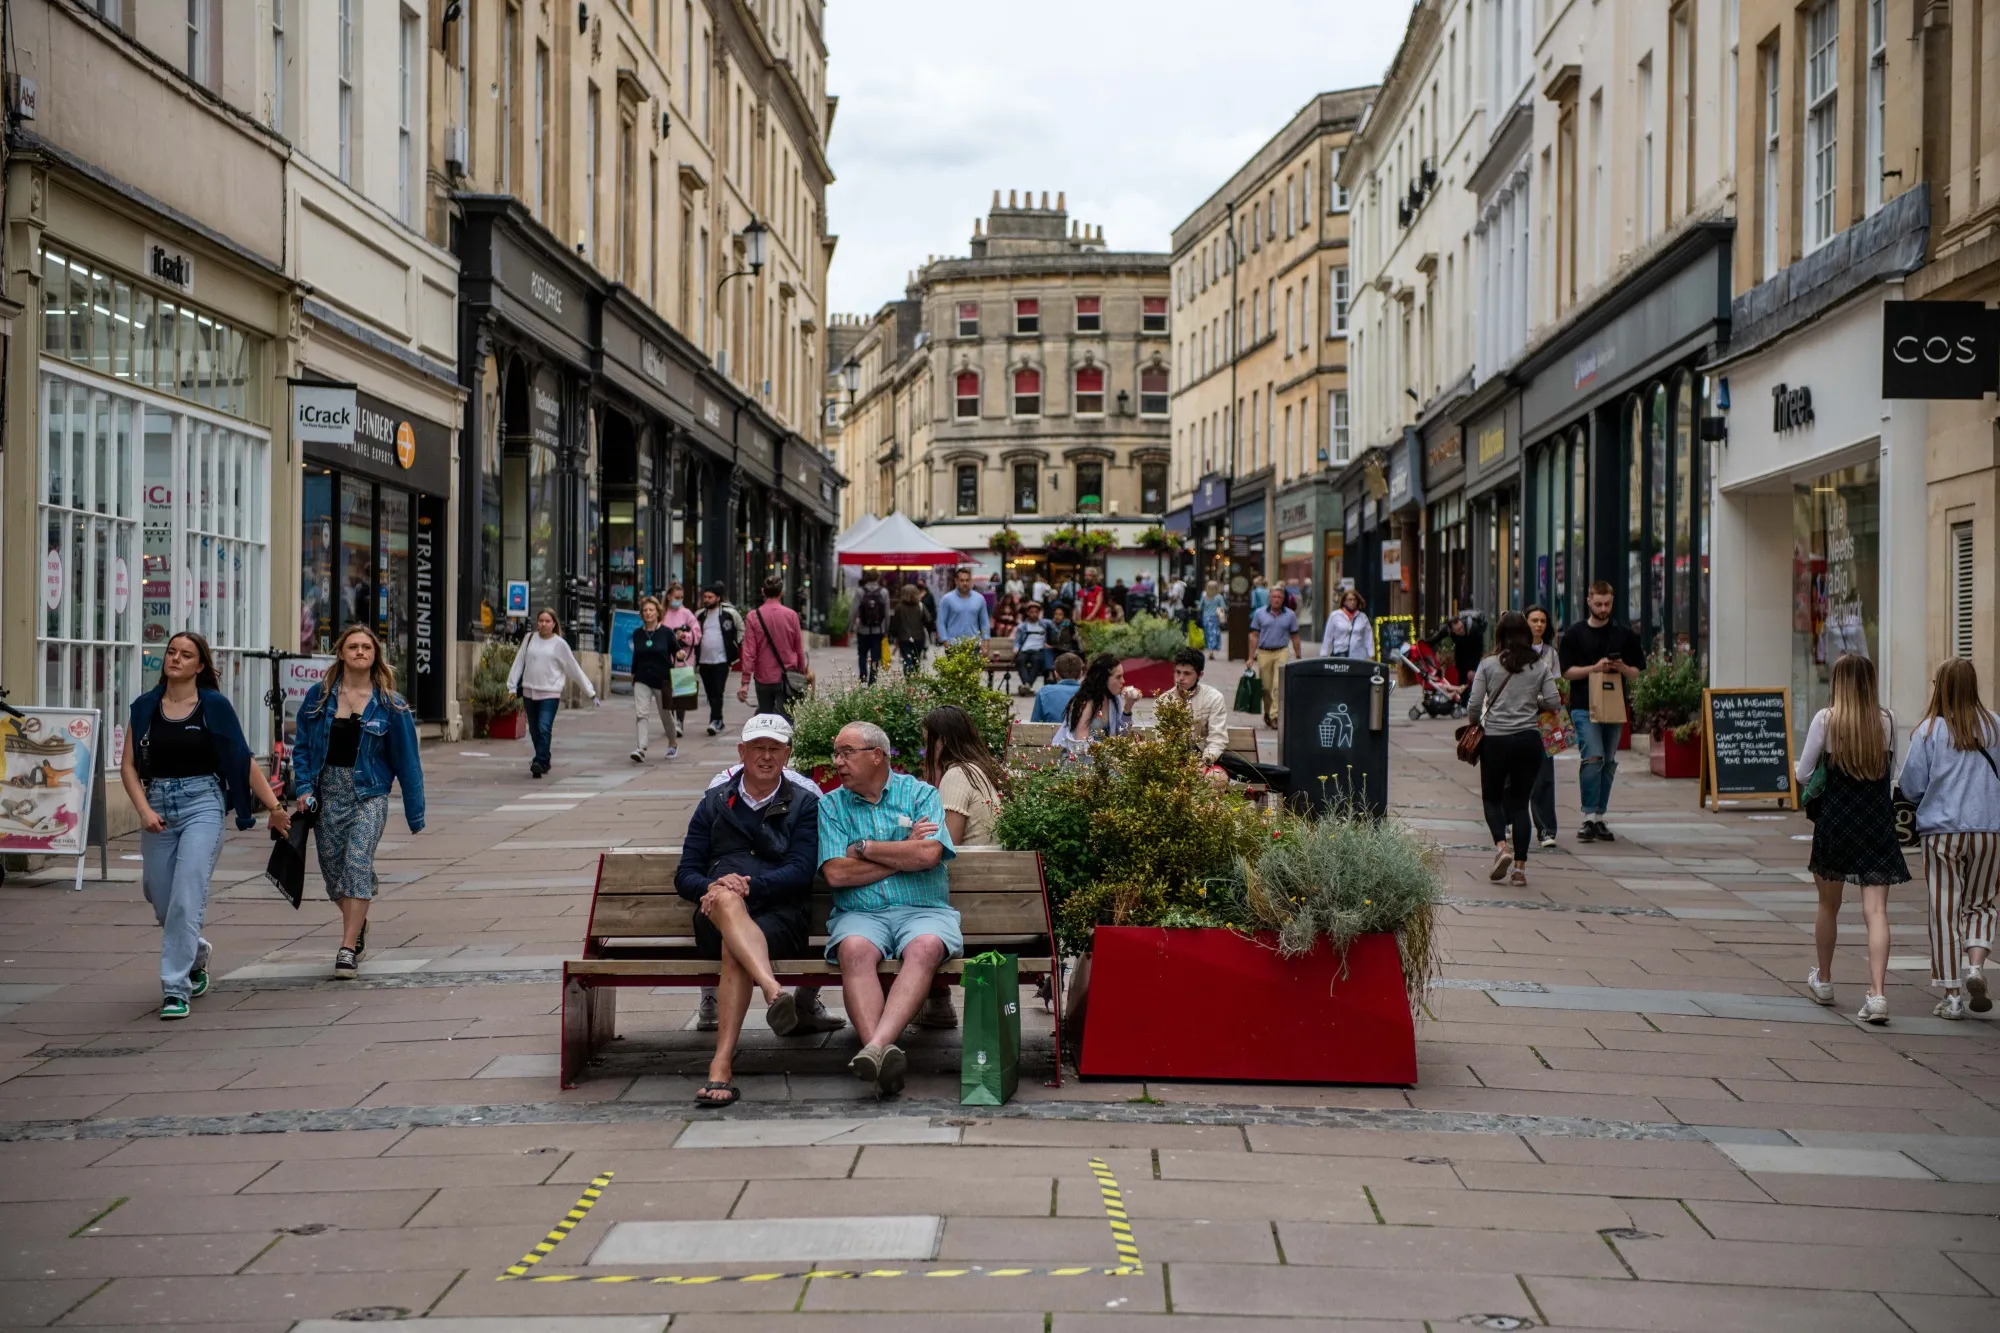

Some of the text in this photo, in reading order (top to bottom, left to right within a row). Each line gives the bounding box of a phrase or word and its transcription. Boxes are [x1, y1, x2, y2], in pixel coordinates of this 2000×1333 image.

[21, 85, 36, 109] Abel
[153, 245, 184, 285] iCrack
[531, 271, 563, 314] POST OFFICE
[1893, 336, 1976, 363] COS
[299, 404, 351, 425] iCrack
[354, 405, 395, 445] ILFINDERS
[372, 446, 394, 466] EXPERTS
[1828, 501, 1844, 530] Life
[1828, 530, 1854, 562] Needs
[1828, 565, 1848, 600] a Big
[417, 531, 432, 674] TRAILFINDERS
[1828, 594, 1862, 626] Network
[290, 664, 327, 679] iCrac
[288, 687, 298, 696] We
[1713, 697, 1784, 709] OWN A BUSINESS
[1714, 709, 1726, 719] OR
[1717, 741, 1777, 750] ABOUT EXCLUSIVE
[1744, 731, 1754, 740] US
[1716, 749, 1741, 758] OFFERS
[1770, 748, 1785, 756] AND
[1724, 756, 1780, 765] YOUR EMPLOYEES
